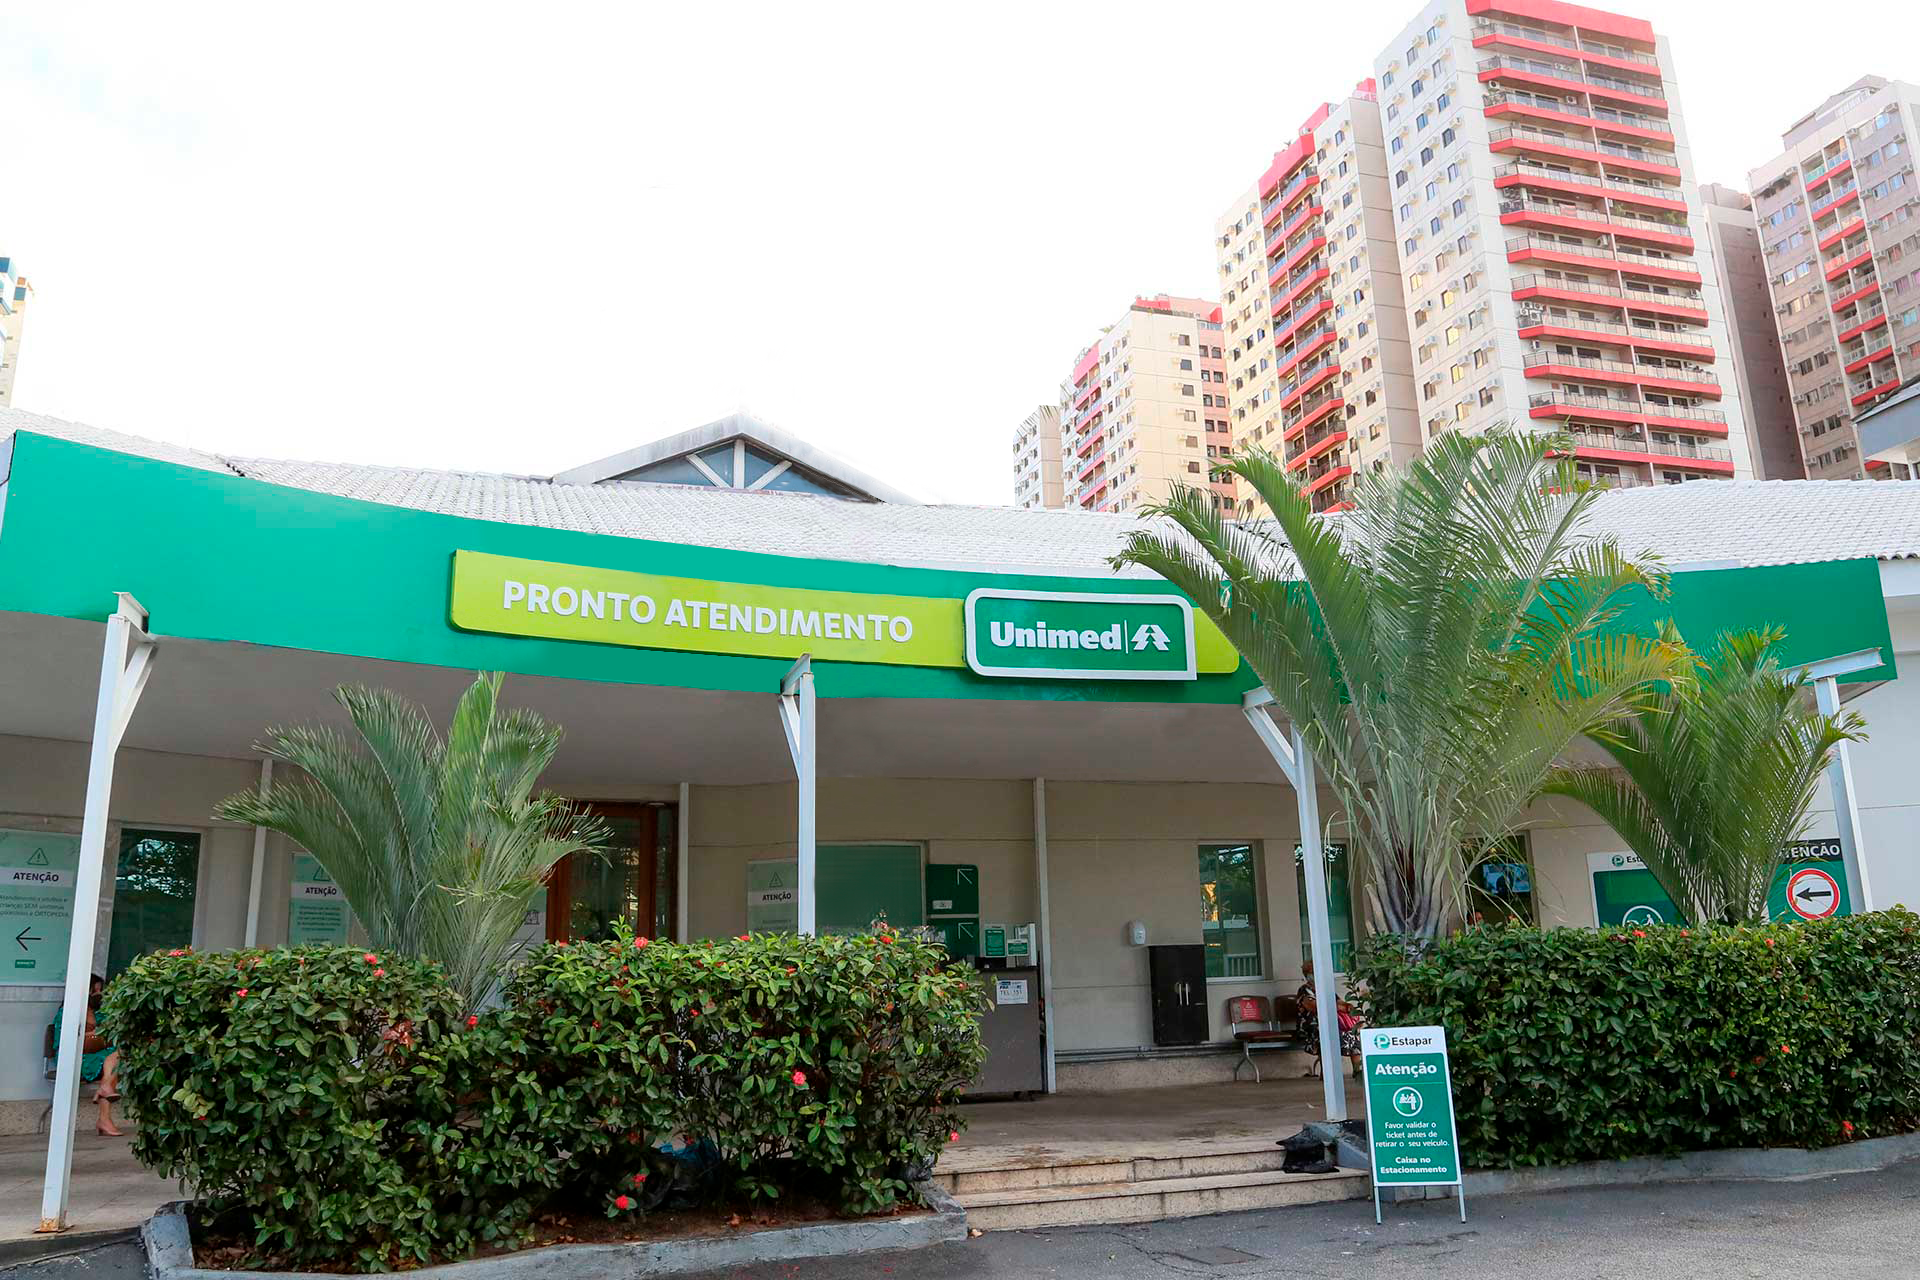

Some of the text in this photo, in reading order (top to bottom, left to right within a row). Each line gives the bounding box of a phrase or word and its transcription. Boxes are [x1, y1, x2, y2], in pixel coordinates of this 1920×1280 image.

[503, 580, 913, 643] PRONTO ATENDIMENTO
[990, 621, 1122, 650] Unimed
[1777, 842, 1840, 858] ENÇÃO
[13, 871, 59, 883] ATENÇÃO
[305, 886, 337, 896] ATENÇÃO
[762, 891, 792, 901] ATENÇÃO
[1391, 1037, 1432, 1047] Estapar
[1375, 1062, 1437, 1078] Atenção
[1384, 1121, 1404, 1129] Favor
[1406, 1120, 1429, 1129] validar
[1386, 1131, 1405, 1139] ticket
[1428, 1130, 1438, 1138] de
[1395, 1156, 1418, 1164] Caixa
[1380, 1166, 1448, 1174] Estacionamento
